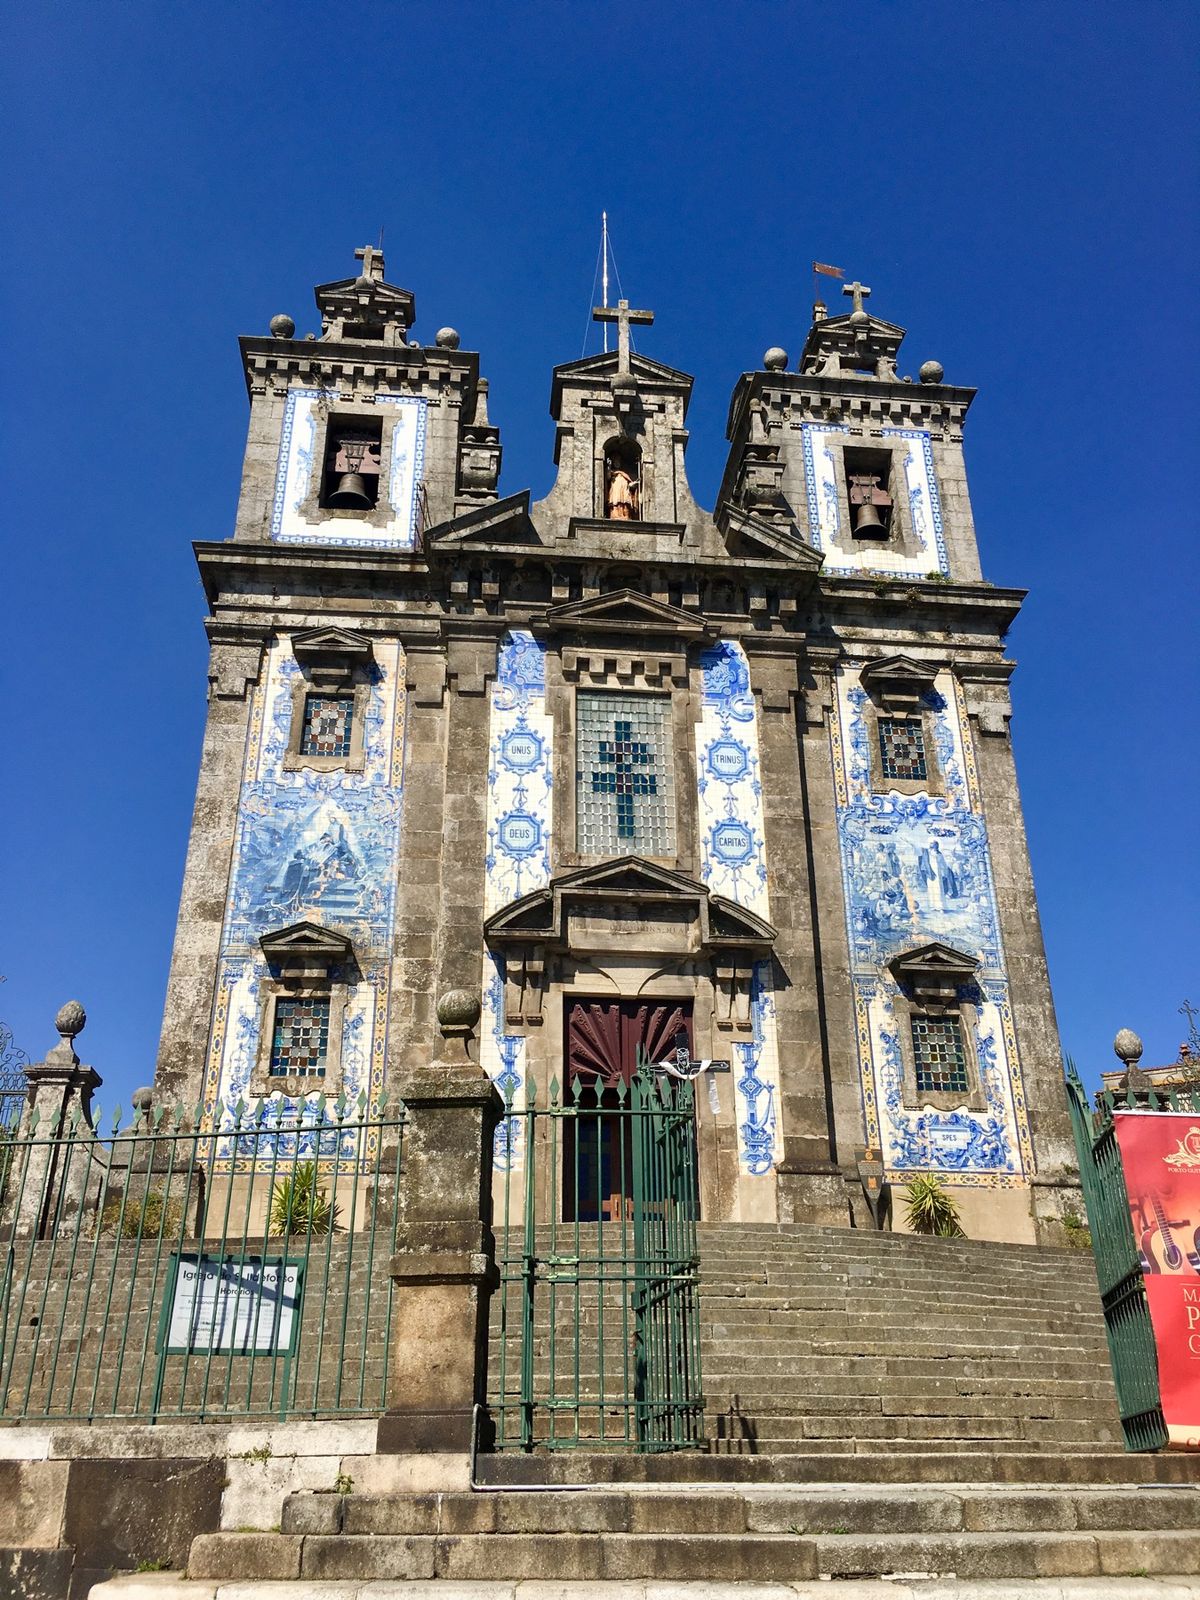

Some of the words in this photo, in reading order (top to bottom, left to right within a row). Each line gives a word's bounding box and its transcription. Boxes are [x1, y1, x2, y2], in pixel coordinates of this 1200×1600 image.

[511, 745, 532, 755] UNUS
[715, 754, 741, 765] TRINUS
[509, 828, 530, 839] DEUS
[718, 837, 747, 848] CARITAS
[1184, 1288, 1200, 1302] M
